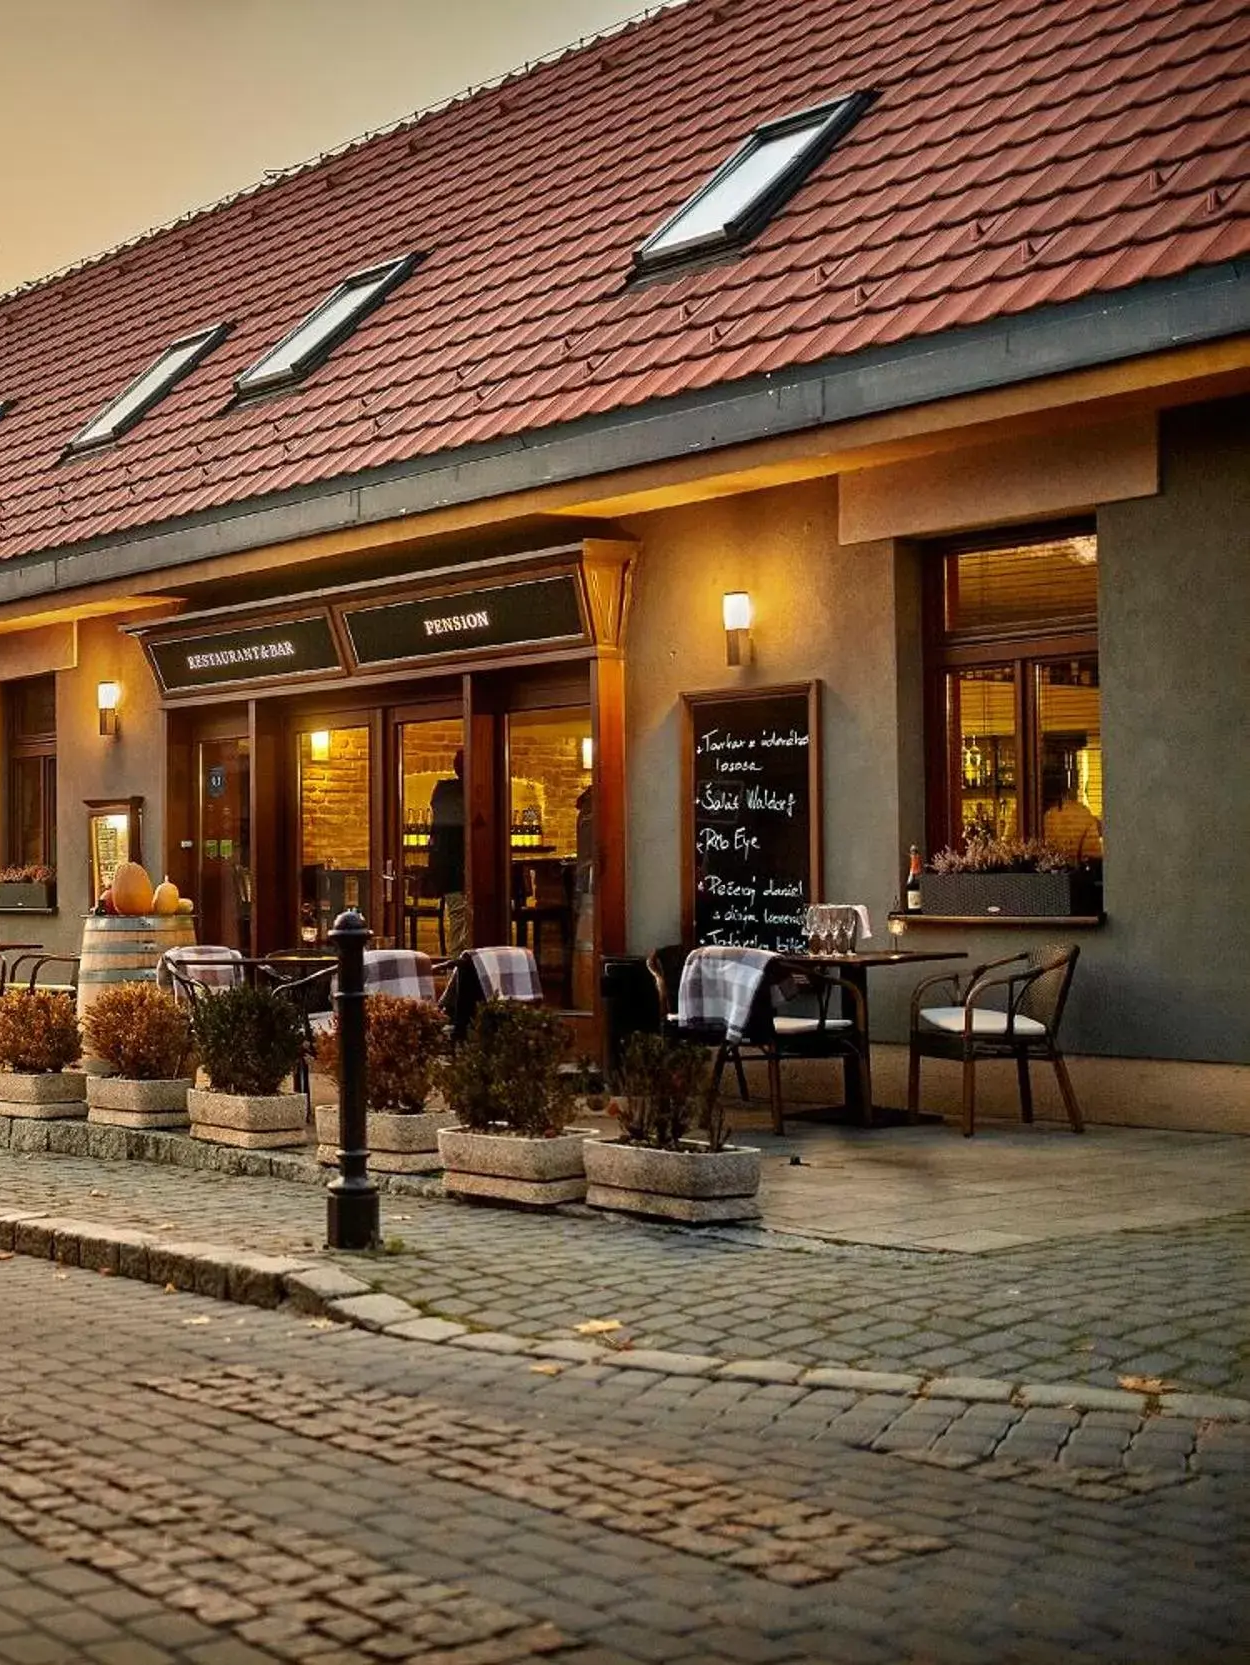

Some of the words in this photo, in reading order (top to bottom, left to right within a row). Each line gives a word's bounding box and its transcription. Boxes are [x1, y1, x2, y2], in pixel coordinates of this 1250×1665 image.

[423, 611, 489, 636] PENSION
[187, 641, 295, 669] RESTAURANT&BAR
[734, 826, 761, 861] Eye
